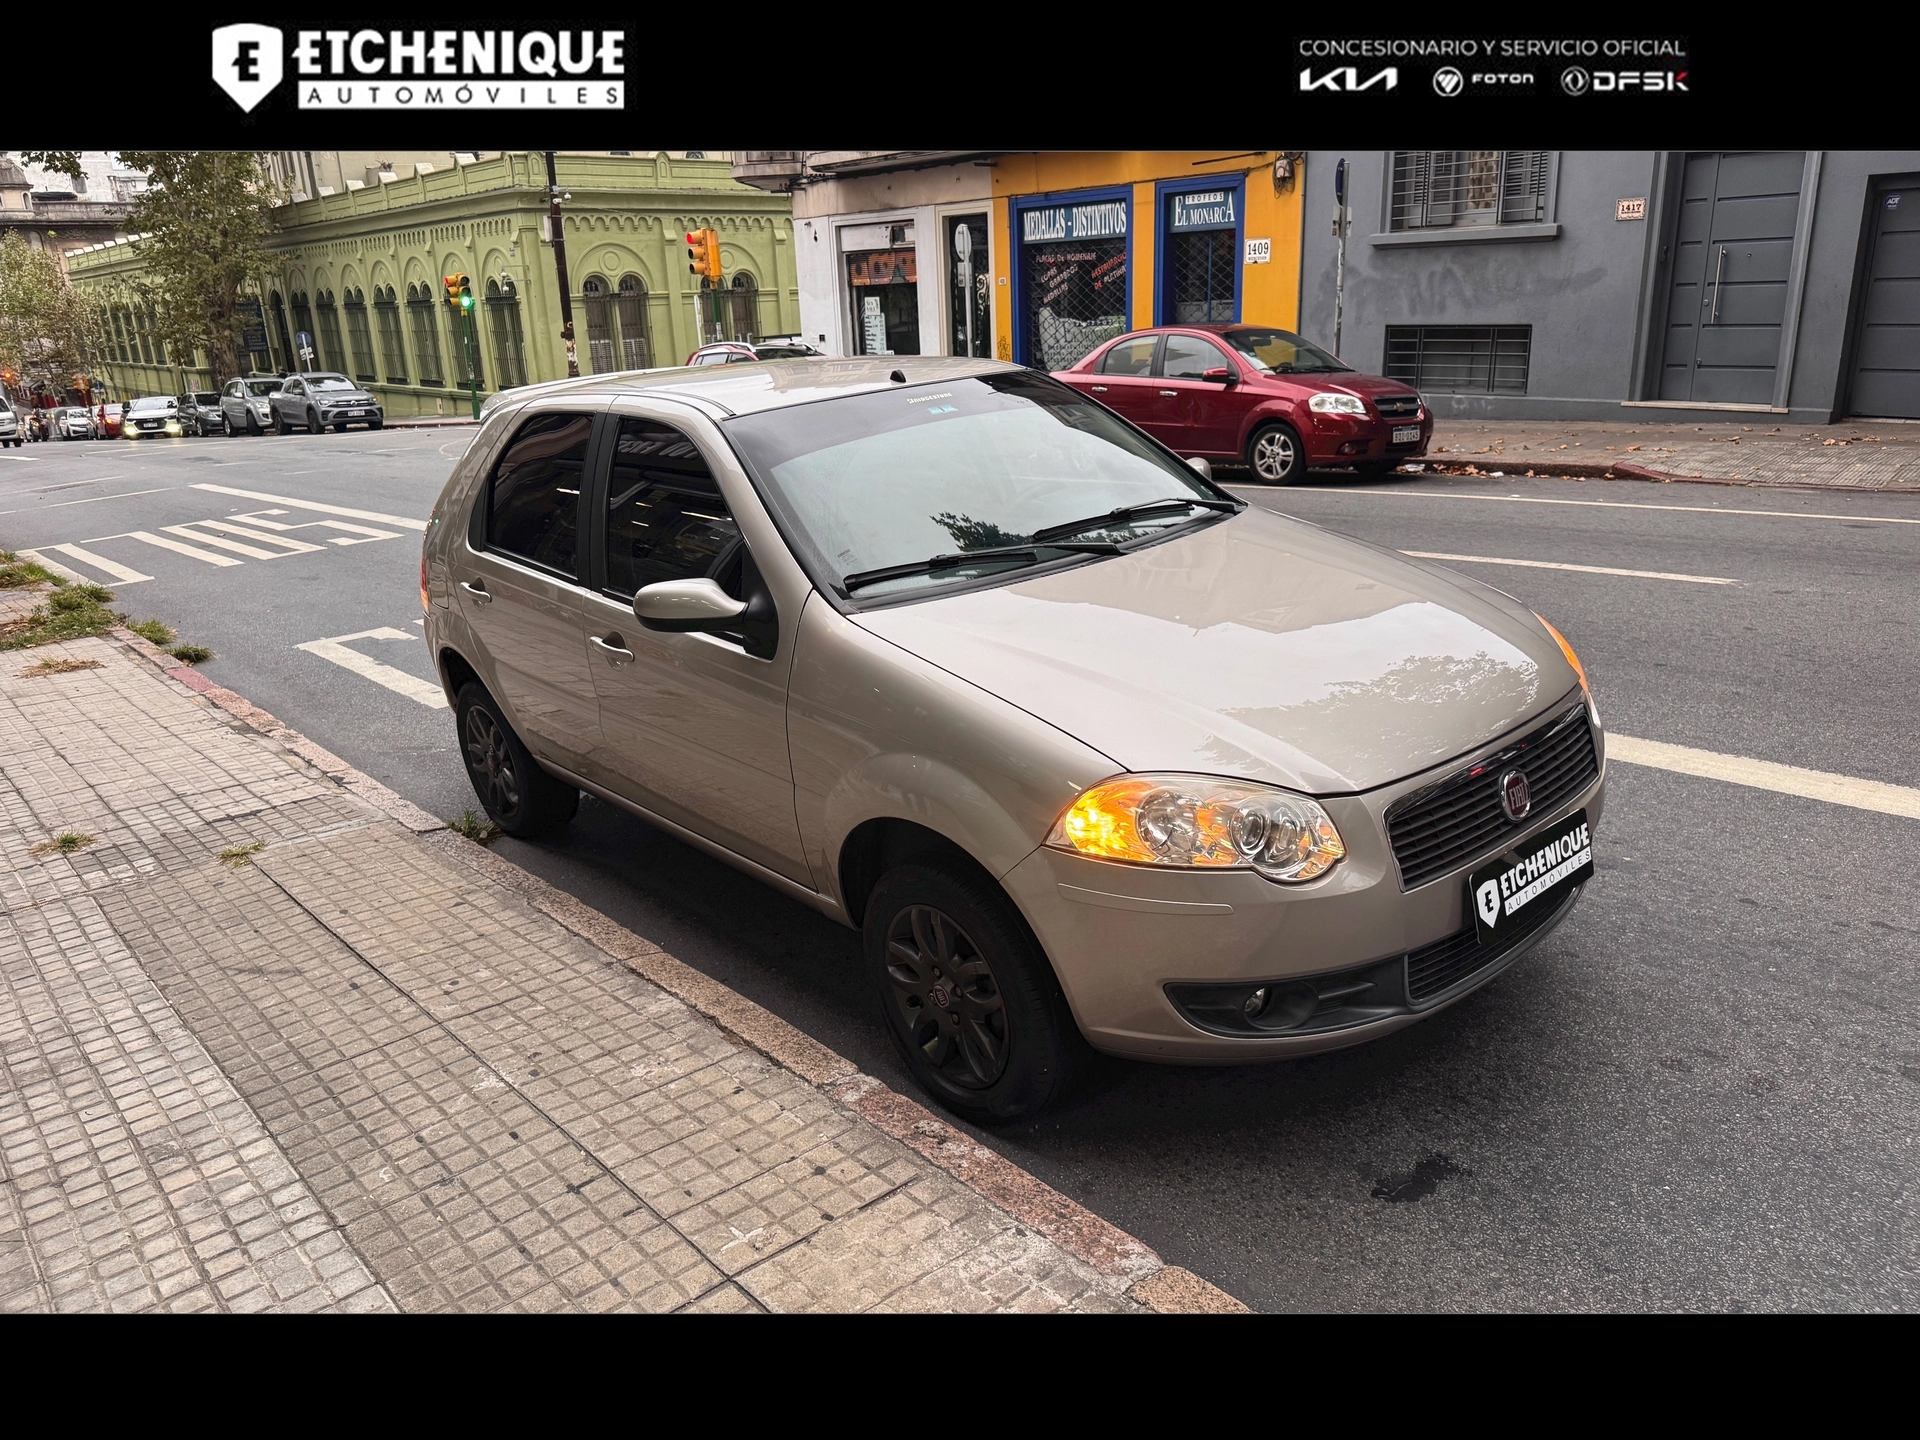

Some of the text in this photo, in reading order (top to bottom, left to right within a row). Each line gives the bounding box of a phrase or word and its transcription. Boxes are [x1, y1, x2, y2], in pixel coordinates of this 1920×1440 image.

[1174, 191, 1235, 227] EL MONARCA
[1186, 192, 1223, 203] TROFEOS
[1621, 203, 1642, 212] 1417
[1023, 207, 1066, 241] MEDALLAS
[1072, 201, 1127, 237] DISTINTIVOS
[1247, 242, 1269, 256] 1409
[1508, 781, 1529, 809] FIAT
[1500, 823, 1590, 898] ETCHENIQUE
